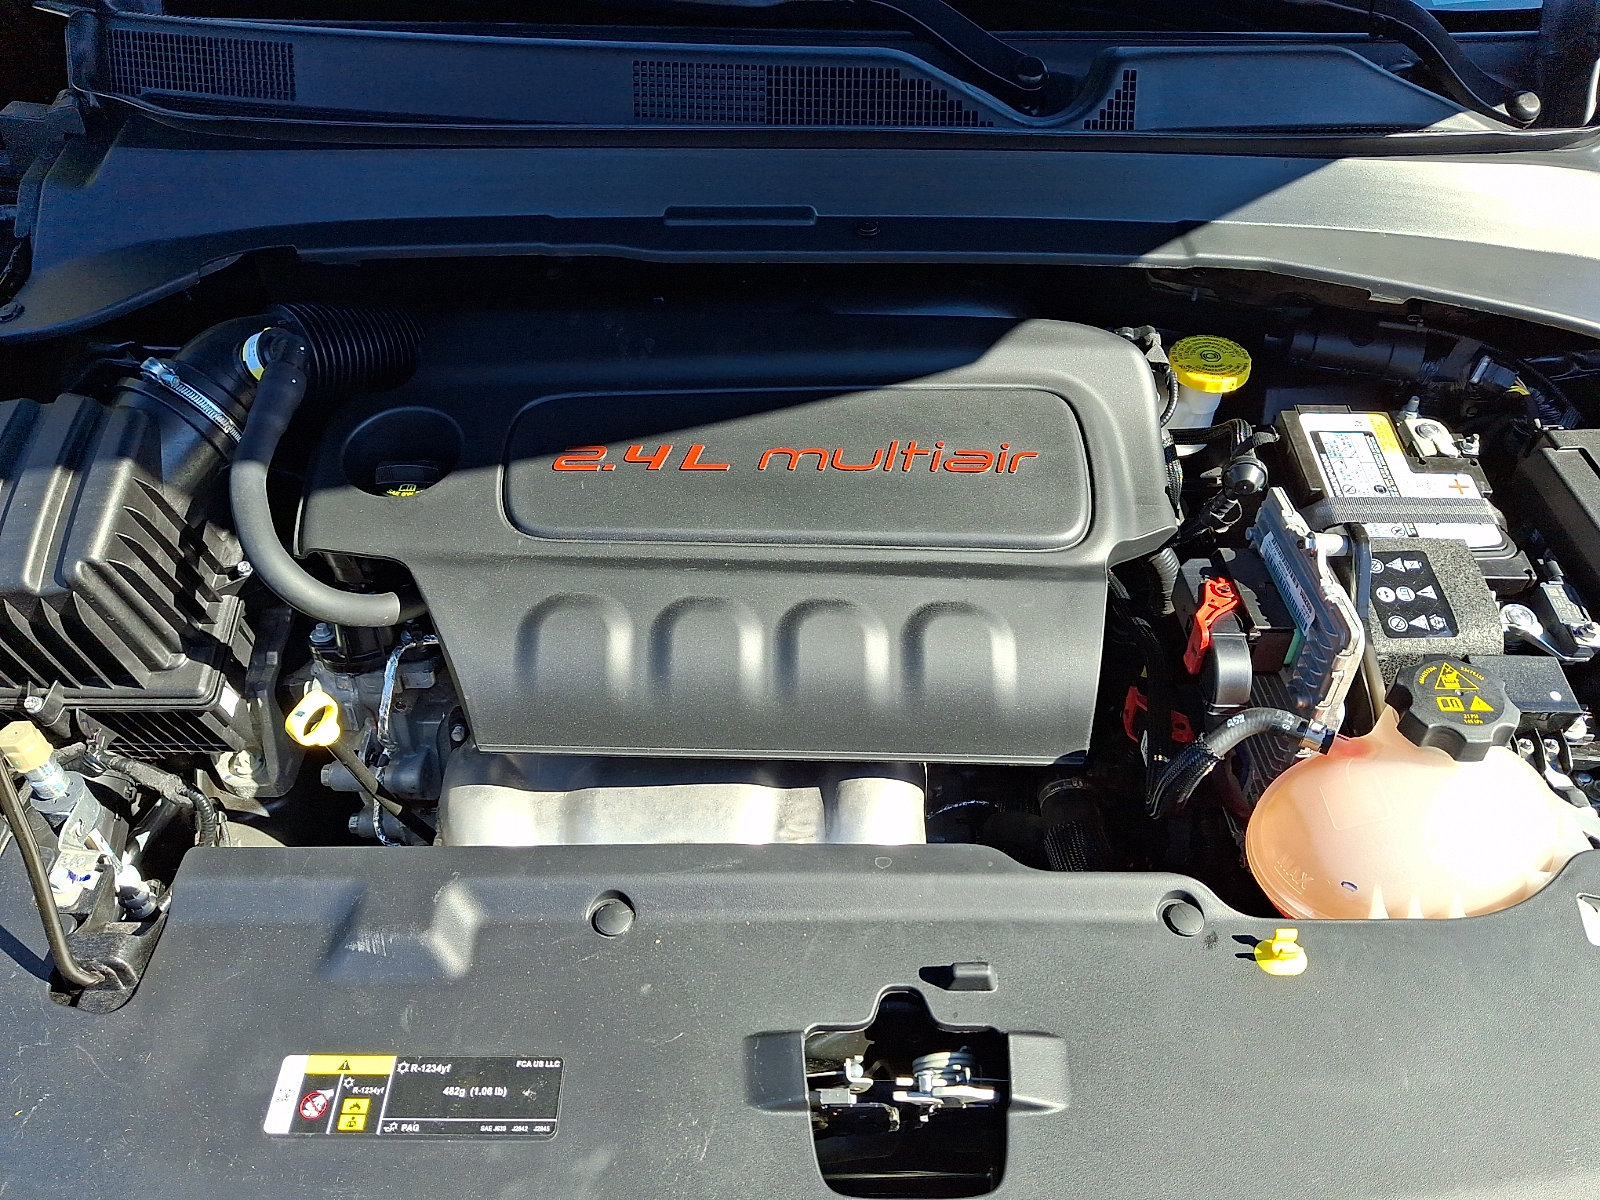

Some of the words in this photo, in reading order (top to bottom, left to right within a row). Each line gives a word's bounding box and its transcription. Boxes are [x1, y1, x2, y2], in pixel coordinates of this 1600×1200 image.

[758, 440, 1039, 474] multiair
[410, 1063, 452, 1075] R-1234yf
[516, 1060, 532, 1068] FCA
[532, 1060, 544, 1068] US
[544, 1060, 562, 1068] LLC
[352, 1086, 386, 1096] R-1234yf
[494, 1086, 508, 1098] lb)
[400, 1123, 420, 1132] PAG
